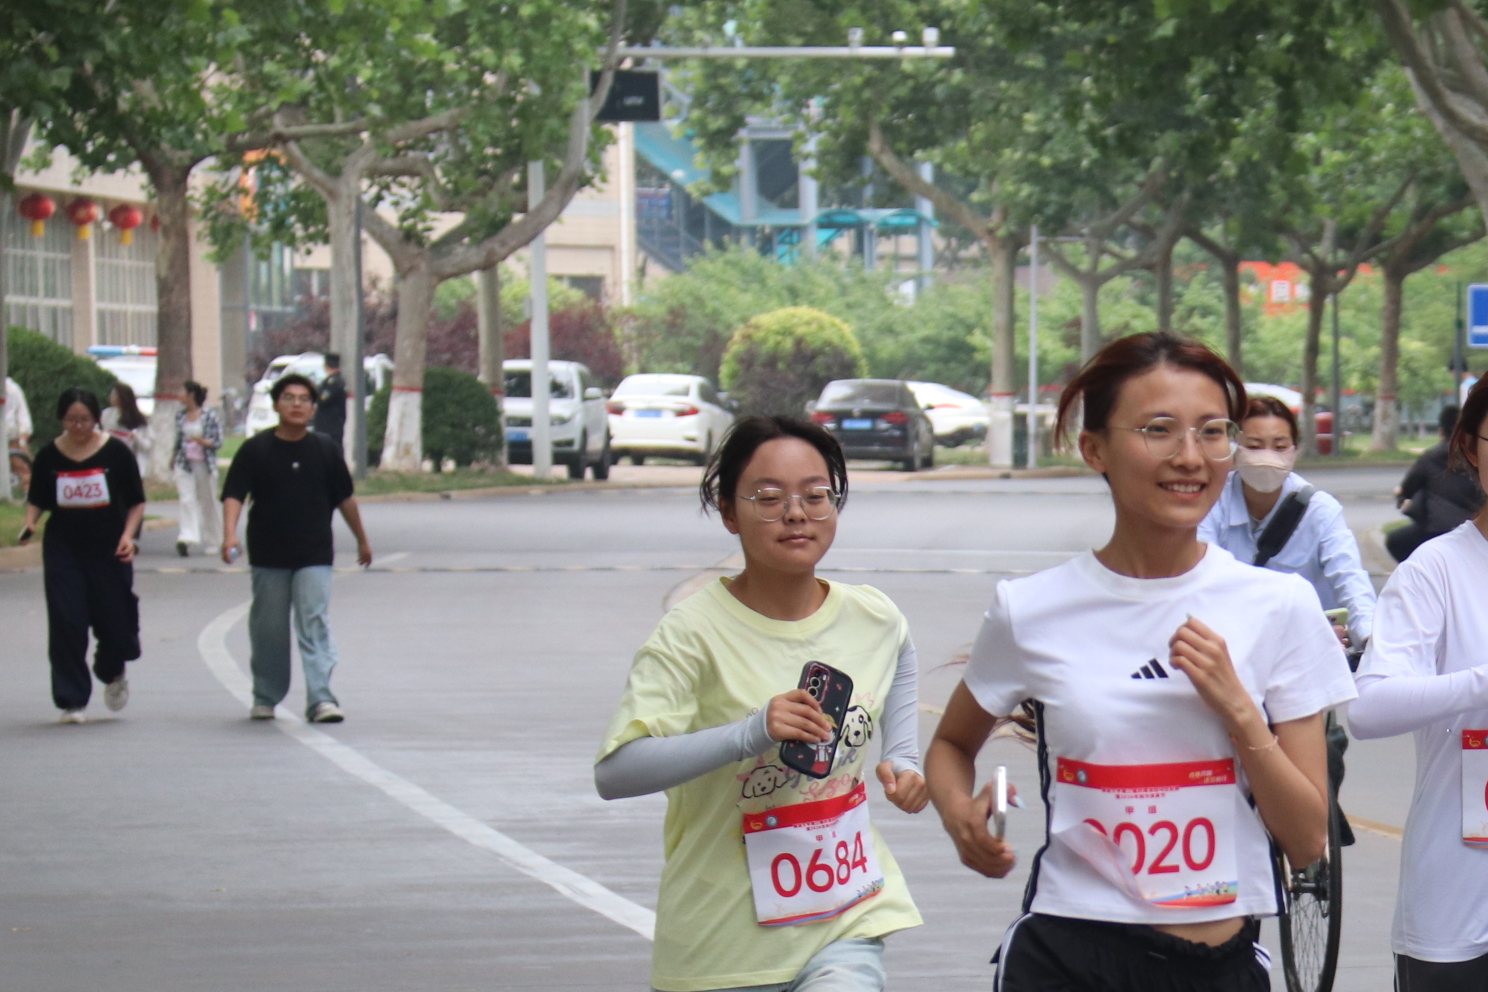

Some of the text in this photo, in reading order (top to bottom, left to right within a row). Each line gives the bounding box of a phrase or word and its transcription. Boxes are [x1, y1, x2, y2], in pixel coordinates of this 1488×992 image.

[63, 483, 103, 500] 0423
[771, 831, 868, 898] 0684
[1083, 817, 1216, 875] 020
